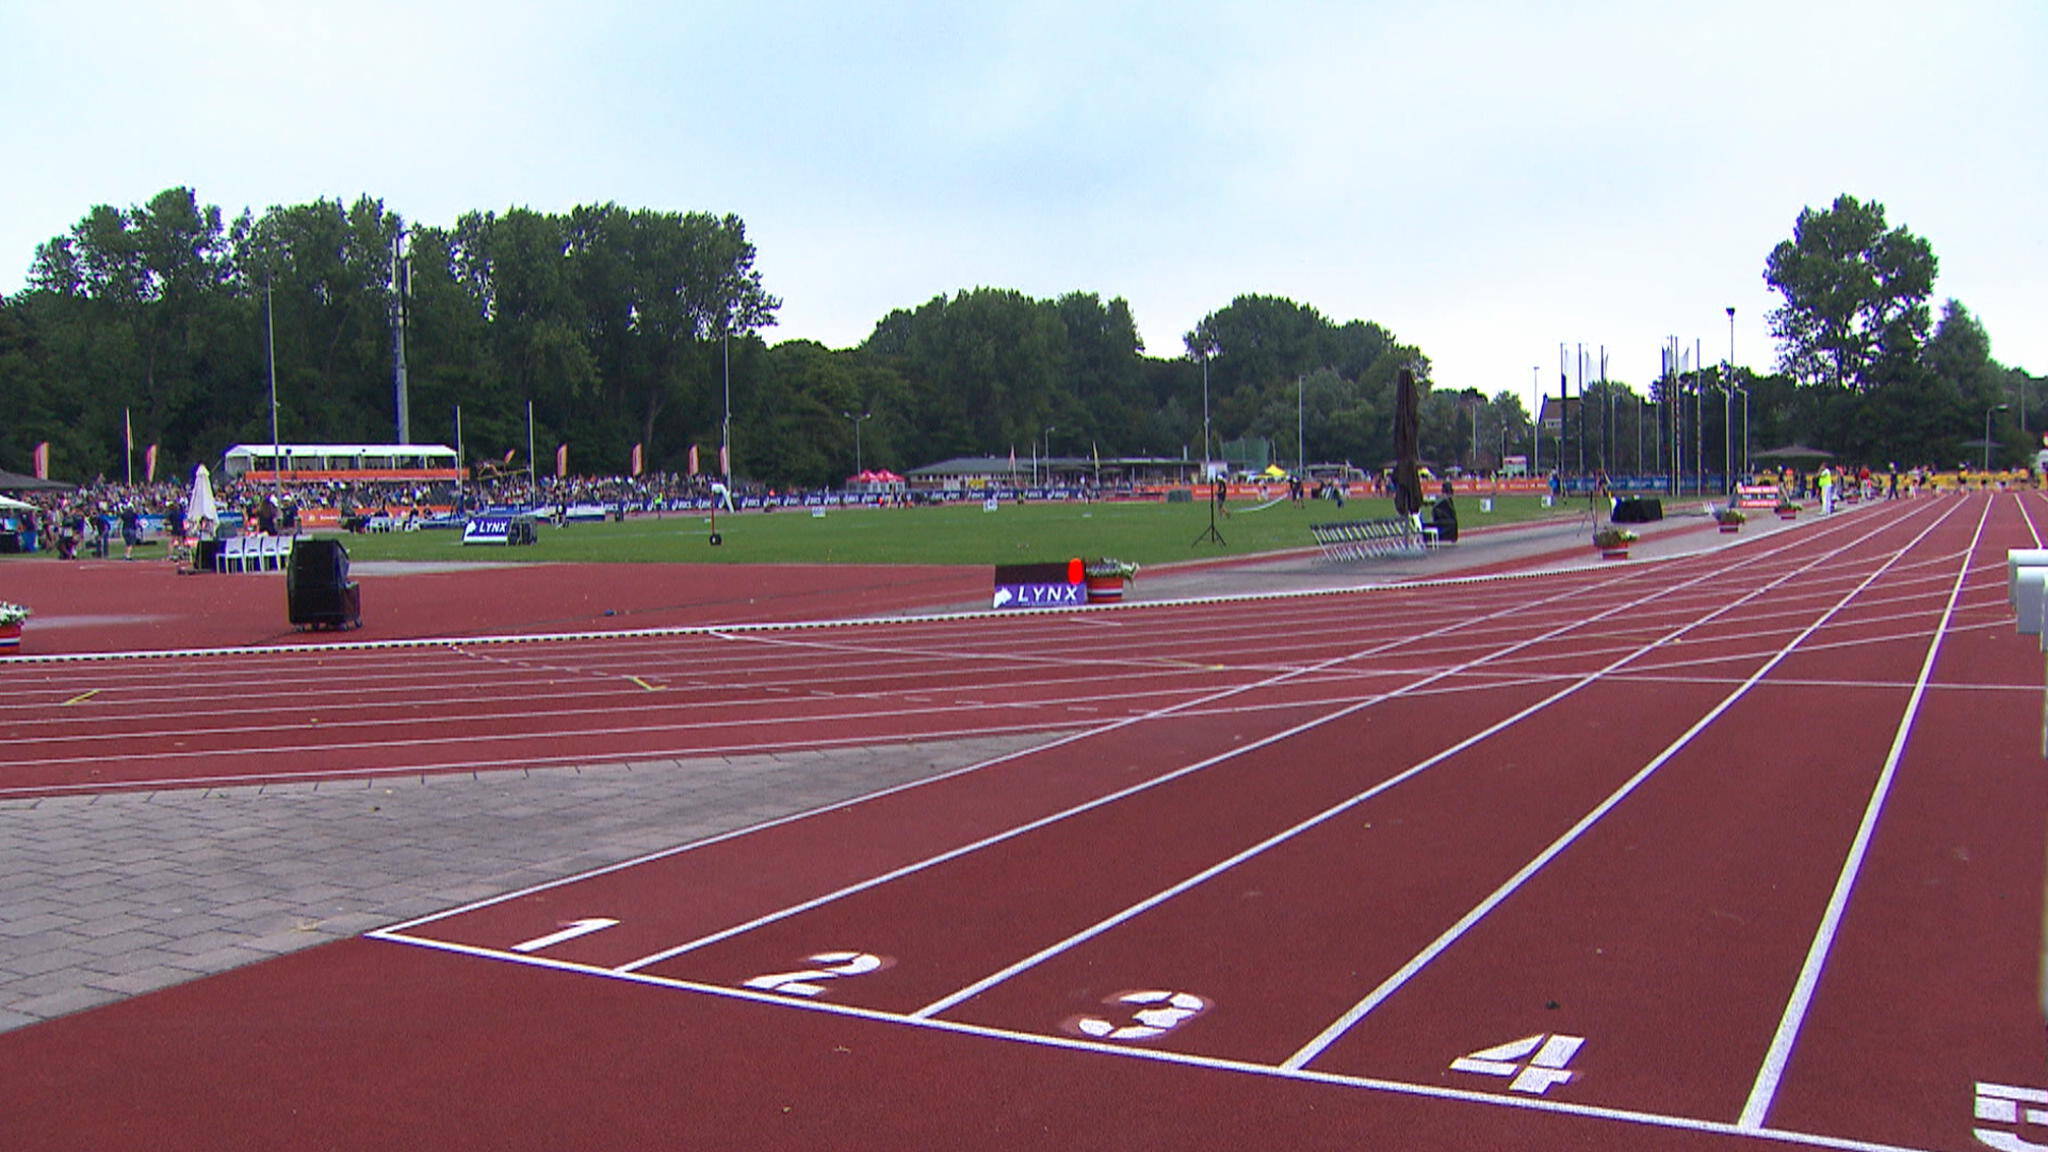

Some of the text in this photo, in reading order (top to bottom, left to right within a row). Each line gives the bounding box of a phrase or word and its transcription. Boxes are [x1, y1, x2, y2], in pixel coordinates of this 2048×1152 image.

[479, 521, 507, 533] LYNX
[1018, 585, 1077, 602] LYNX
[509, 917, 622, 953] 1
[741, 953, 883, 996] 2
[1078, 990, 1205, 1039] 3
[1449, 1034, 1586, 1094] 4
